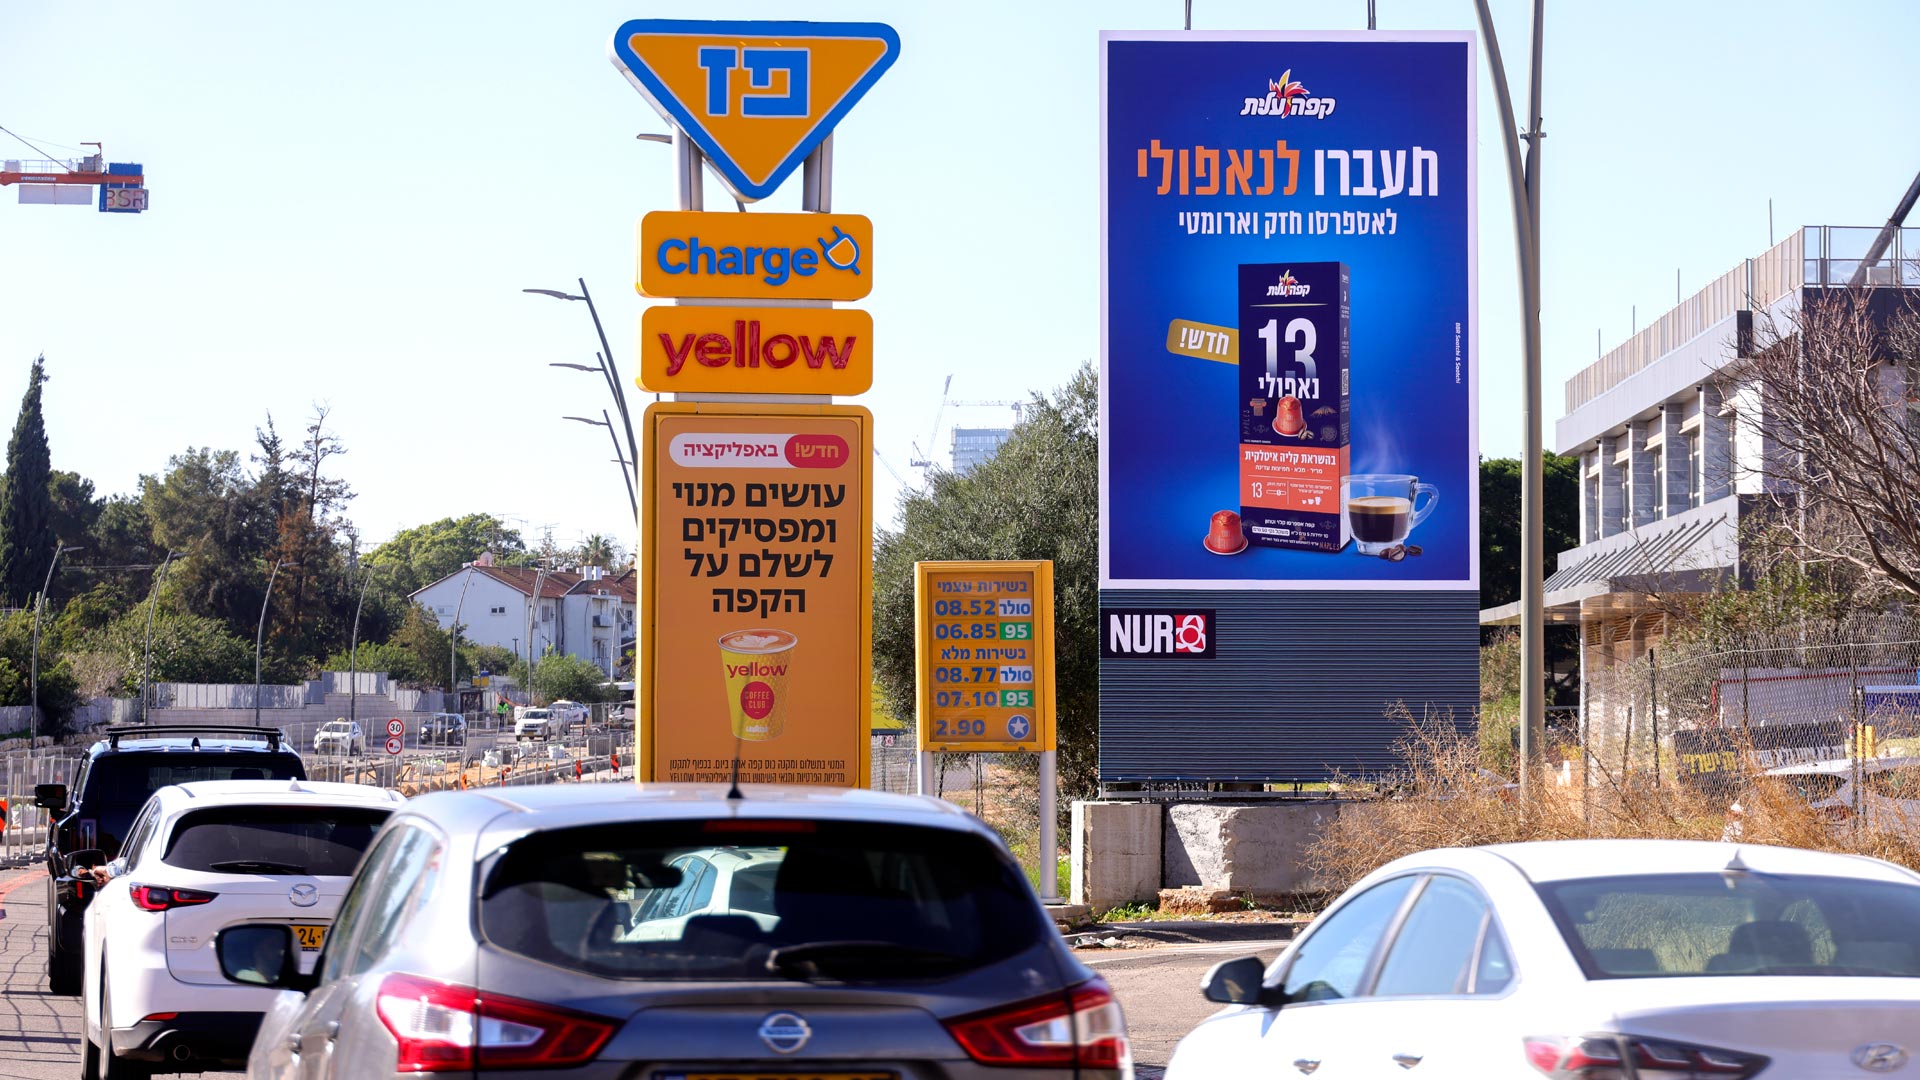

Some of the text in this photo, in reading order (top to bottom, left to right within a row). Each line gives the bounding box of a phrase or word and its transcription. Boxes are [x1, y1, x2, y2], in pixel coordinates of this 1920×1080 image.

[698, 47, 810, 117] פז
[1240, 91, 1336, 119] קפה עלית
[1137, 139, 1439, 199] תעברו לנאפולי
[1178, 208, 1398, 239] לאספרסו חזק וארומטי
[657, 236, 819, 287] Charge
[1266, 282, 1310, 297] קפה עלית
[658, 319, 857, 377] yellow
[1179, 327, 1230, 356] חדש!
[1258, 317, 1317, 378] 13
[1258, 371, 1320, 399] נאפולי
[683, 442, 839, 460] חדש! באפליקציה
[1244, 449, 1336, 465] בהשראת קליה איטלקית
[672, 482, 846, 508] עושים מנוי
[1251, 481, 1263, 498] 13
[682, 517, 837, 548] ומפסיקים
[684, 548, 834, 578] לשלם על
[937, 581, 1028, 593] בשירות עצמי
[713, 588, 806, 619] הקפה
[934, 599, 1031, 617] סולר 08.52
[935, 623, 1028, 640] 06.85 95
[1110, 614, 1174, 653] NUR
[941, 645, 1027, 660] בשירות מלא
[726, 662, 788, 679] yellow
[935, 667, 1033, 683] סולר 08.77
[744, 691, 770, 700] COFFEE
[936, 691, 1029, 707] 07.10 95
[390, 723, 401, 732] 30
[936, 719, 985, 736] 2.90
